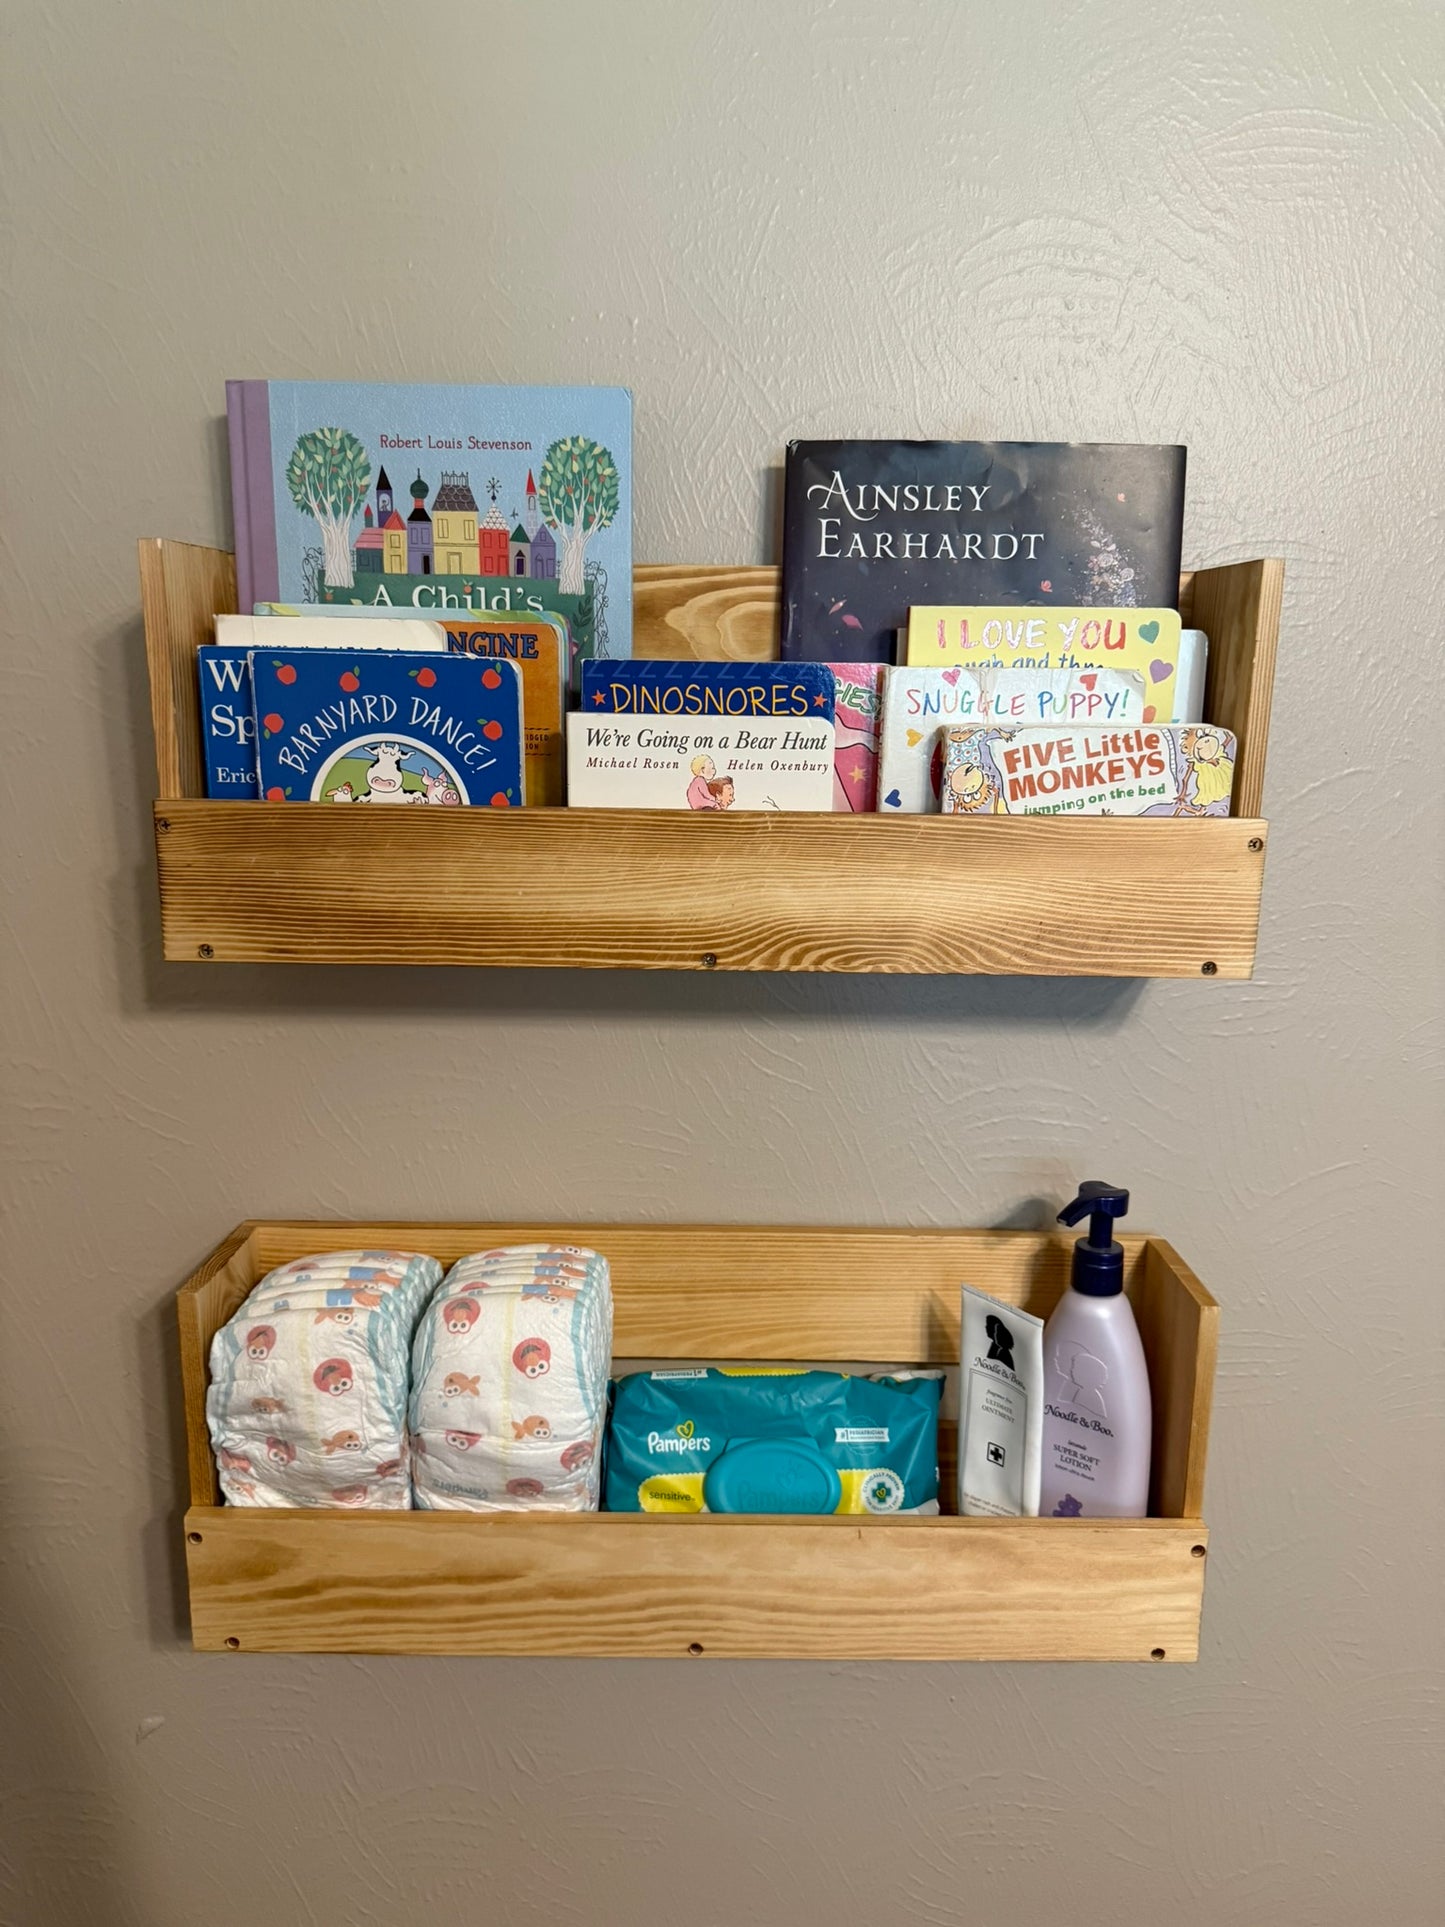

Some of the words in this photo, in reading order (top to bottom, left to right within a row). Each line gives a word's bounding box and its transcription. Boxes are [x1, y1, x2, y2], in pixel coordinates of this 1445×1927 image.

[380, 434, 422, 449] Robert
[428, 435, 462, 450] Louis
[468, 436, 532, 450] Stevenson
[807, 470, 992, 521] AINSLEY
[816, 517, 1044, 561] EARHARDT
[370, 584, 394, 607] A
[412, 584, 544, 612] Child's
[937, 619, 947, 649] I
[960, 618, 1047, 650] LOVE
[1058, 617, 1126, 651] YOU
[609, 683, 809, 716] DINOSNORES
[906, 689, 1026, 717] SNUGGLE
[1037, 689, 1130, 719] PUPPY!
[279, 695, 398, 775] BARNYARD
[408, 696, 497, 774] DANCE!
[586, 727, 631, 748] We're
[637, 728, 690, 754] Going
[693, 735, 713, 749] on
[718, 736, 730, 749] a
[735, 730, 778, 750] Bear
[780, 731, 828, 750] Hunt
[586, 757, 638, 769] Michael
[643, 758, 680, 769] Rosen
[1003, 737, 1077, 774] FIVE
[1084, 729, 1160, 759] Little
[216, 766, 257, 784] Eric
[727, 759, 764, 771] Helen
[770, 759, 829, 774] Oxenbury
[1008, 750, 1165, 802] MONKEYS
[1088, 793, 1107, 804] on
[1109, 788, 1134, 800] the
[1138, 783, 1166, 797] bed
[973, 1357, 1001, 1375] Noodle
[1002, 1368, 1009, 1379] &
[1044, 1404, 1079, 1424] Noodle
[1079, 1417, 1090, 1428] &
[648, 1431, 711, 1455] Pampers
[1053, 1444, 1079, 1458] SUPER
[1080, 1453, 1101, 1466] SOFT
[1060, 1455, 1092, 1472] LOTION
[649, 1491, 692, 1502] sensitive
